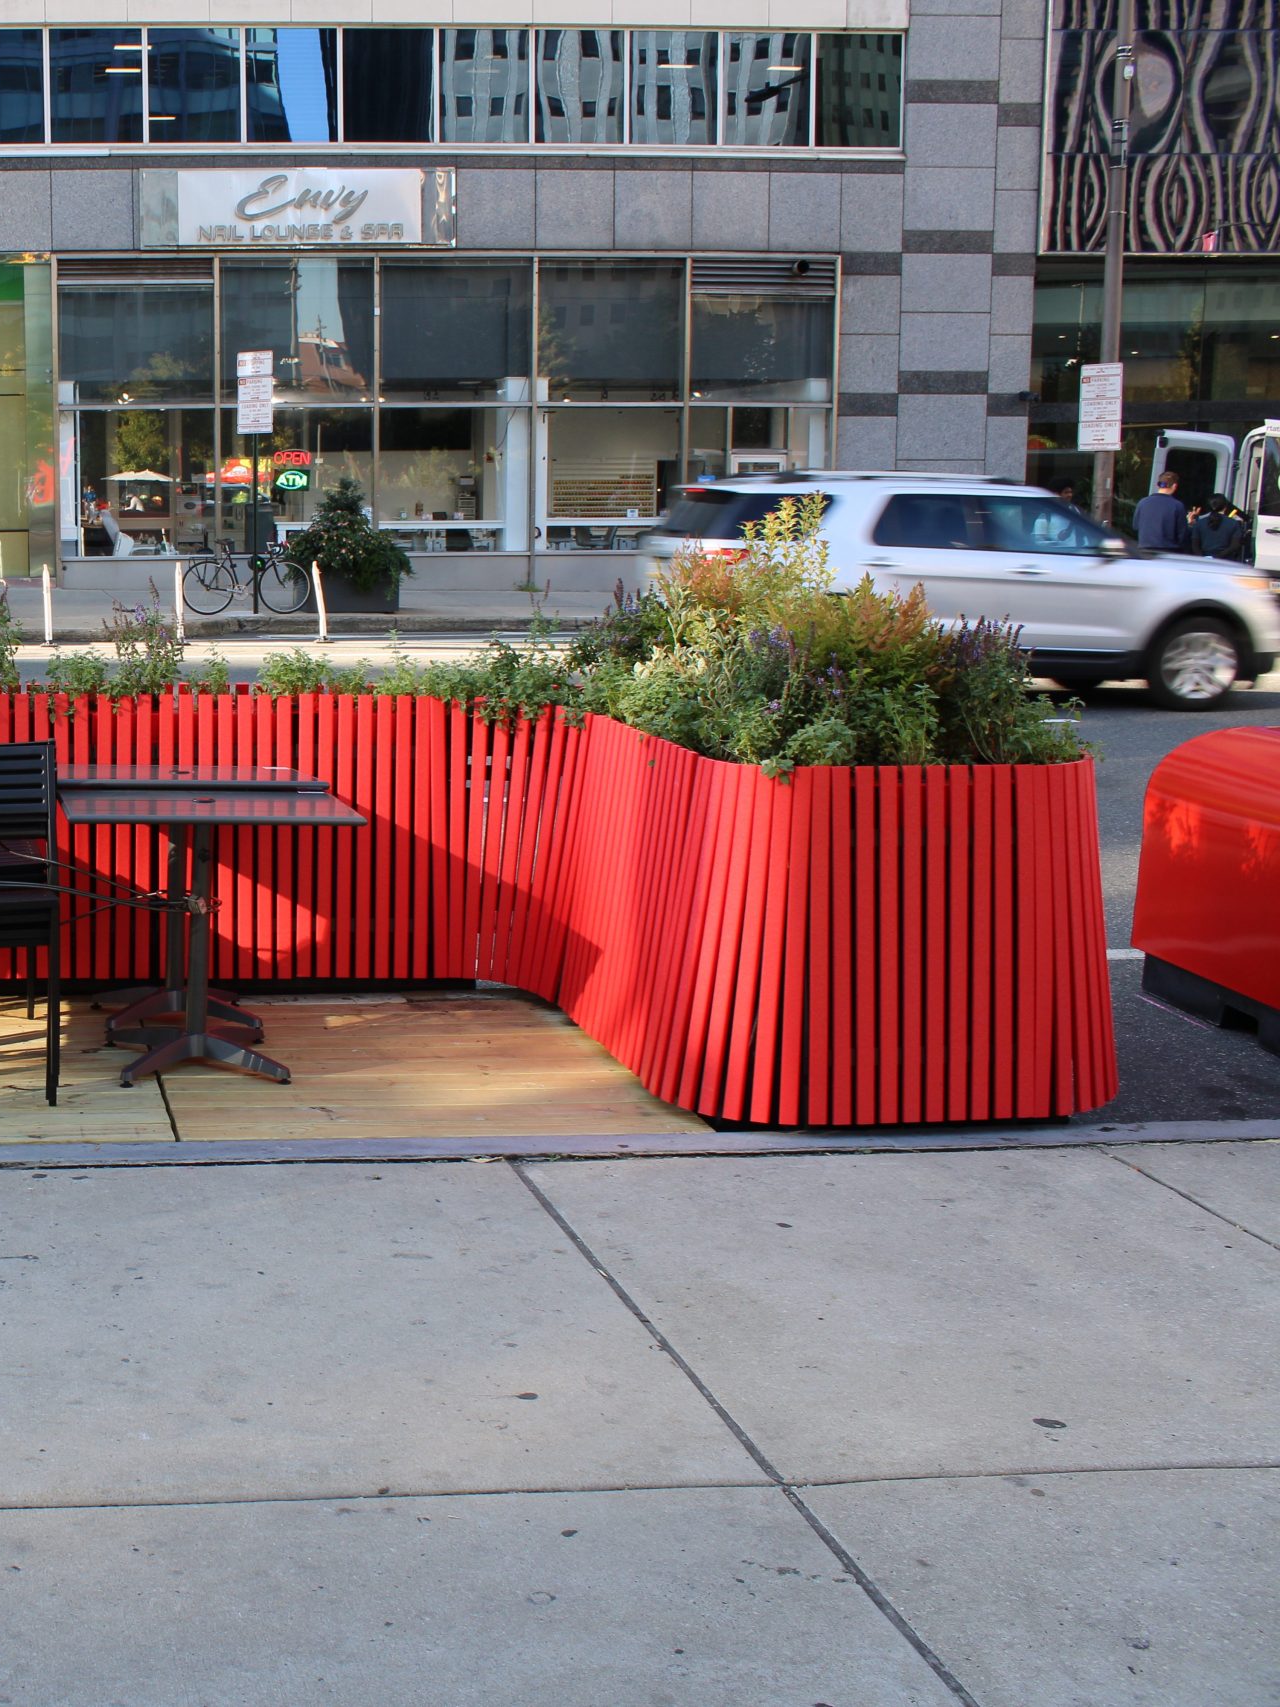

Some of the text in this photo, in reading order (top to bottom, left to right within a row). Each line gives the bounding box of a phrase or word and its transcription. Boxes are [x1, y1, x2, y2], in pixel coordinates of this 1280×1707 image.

[235, 174, 368, 224] Envy
[198, 223, 404, 242] NAIL LOUNGE & SPA
[273, 451, 312, 465] OPEN
[276, 473, 308, 487] ATM
